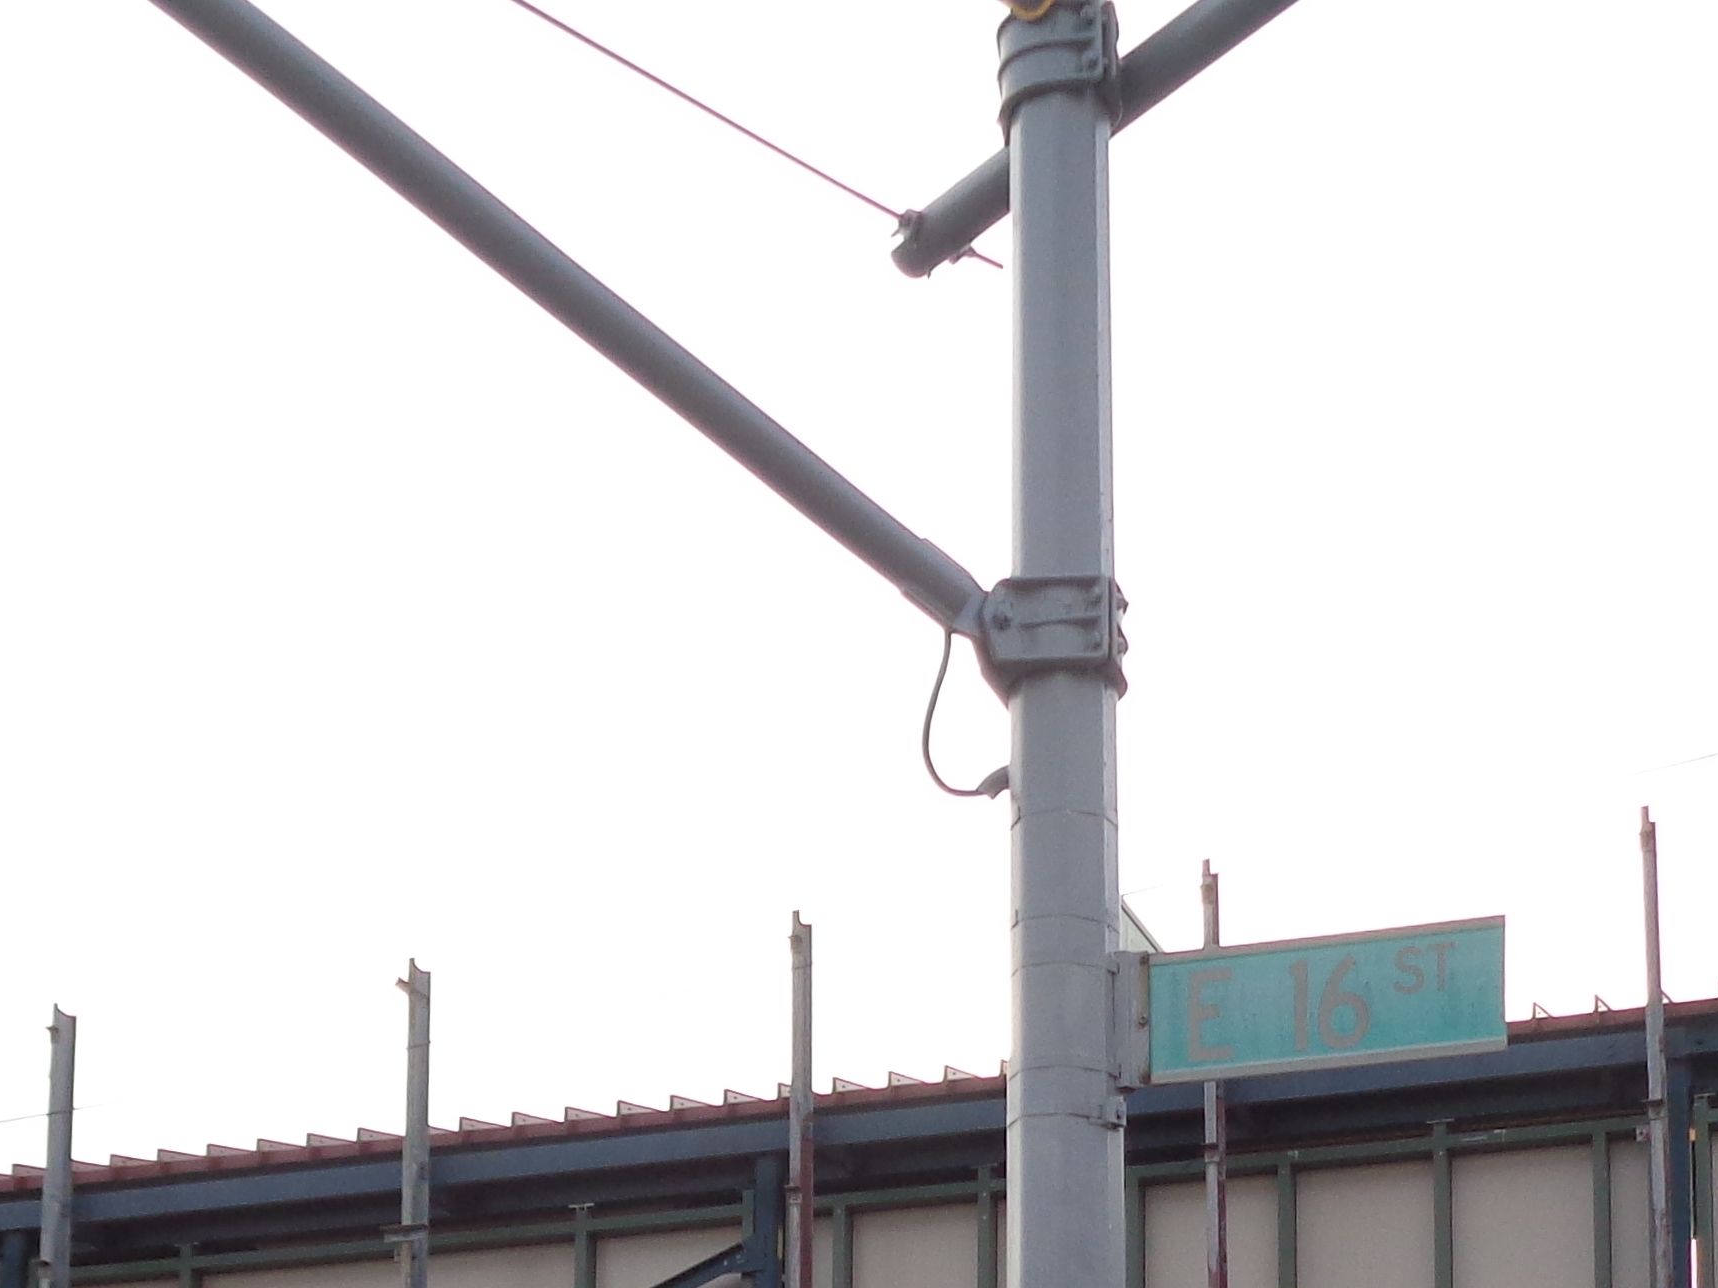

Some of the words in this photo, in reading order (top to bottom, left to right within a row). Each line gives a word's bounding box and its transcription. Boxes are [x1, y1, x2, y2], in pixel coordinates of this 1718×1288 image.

[1188, 966, 1234, 1063] E
[1288, 953, 1371, 1051] 16
[1393, 941, 1456, 996] ST
